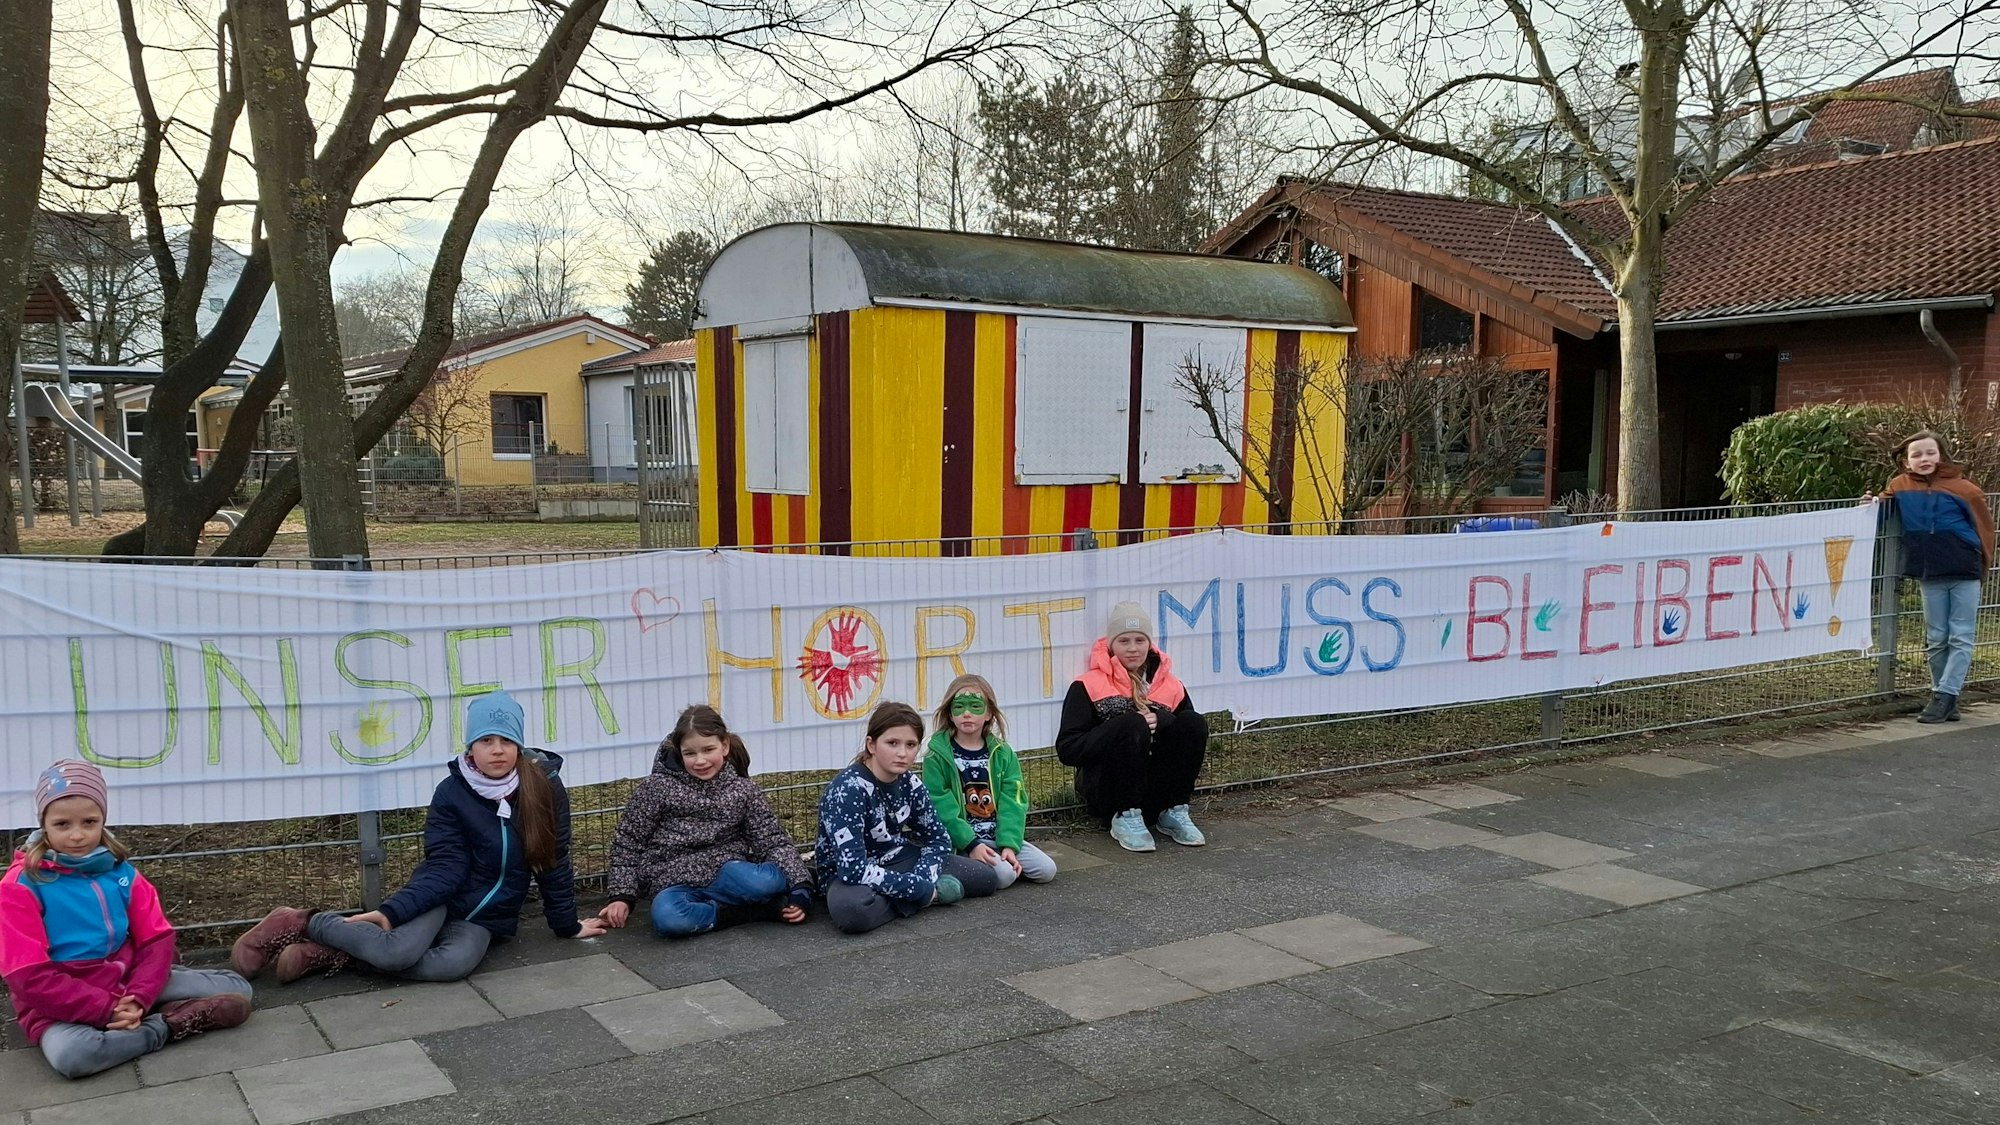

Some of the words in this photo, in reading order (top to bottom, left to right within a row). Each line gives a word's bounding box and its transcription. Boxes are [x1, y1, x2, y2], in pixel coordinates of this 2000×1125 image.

[68, 616, 620, 768] UNSER
[702, 597, 1086, 723] HORT
[1157, 576, 1407, 678] MUSS
